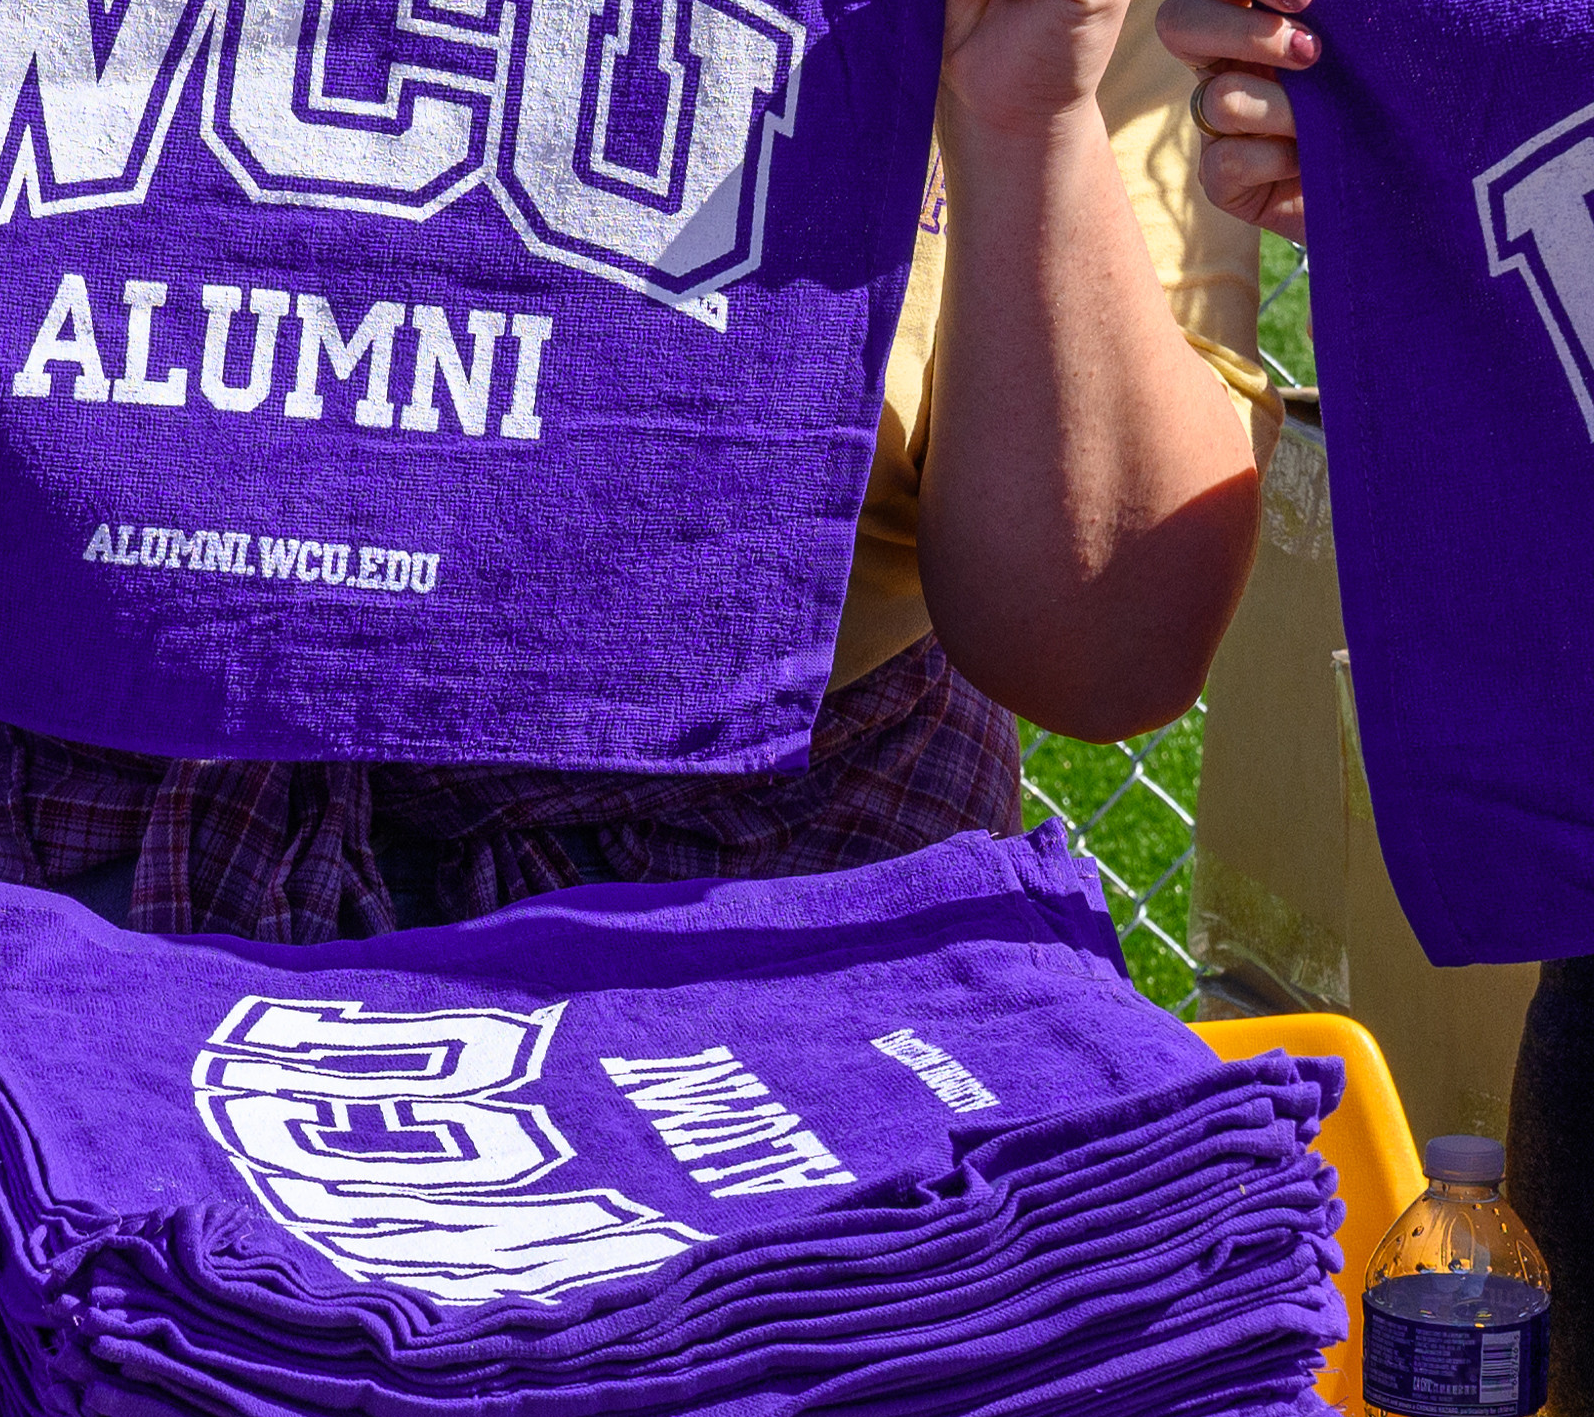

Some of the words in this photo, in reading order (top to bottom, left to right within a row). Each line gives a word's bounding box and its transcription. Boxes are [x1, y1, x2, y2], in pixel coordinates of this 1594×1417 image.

[11, 272, 554, 441] ALUMNI
[83, 523, 441, 596] ALUMNI.WCU.EDU
[599, 1046, 860, 1199] ALUMNI
